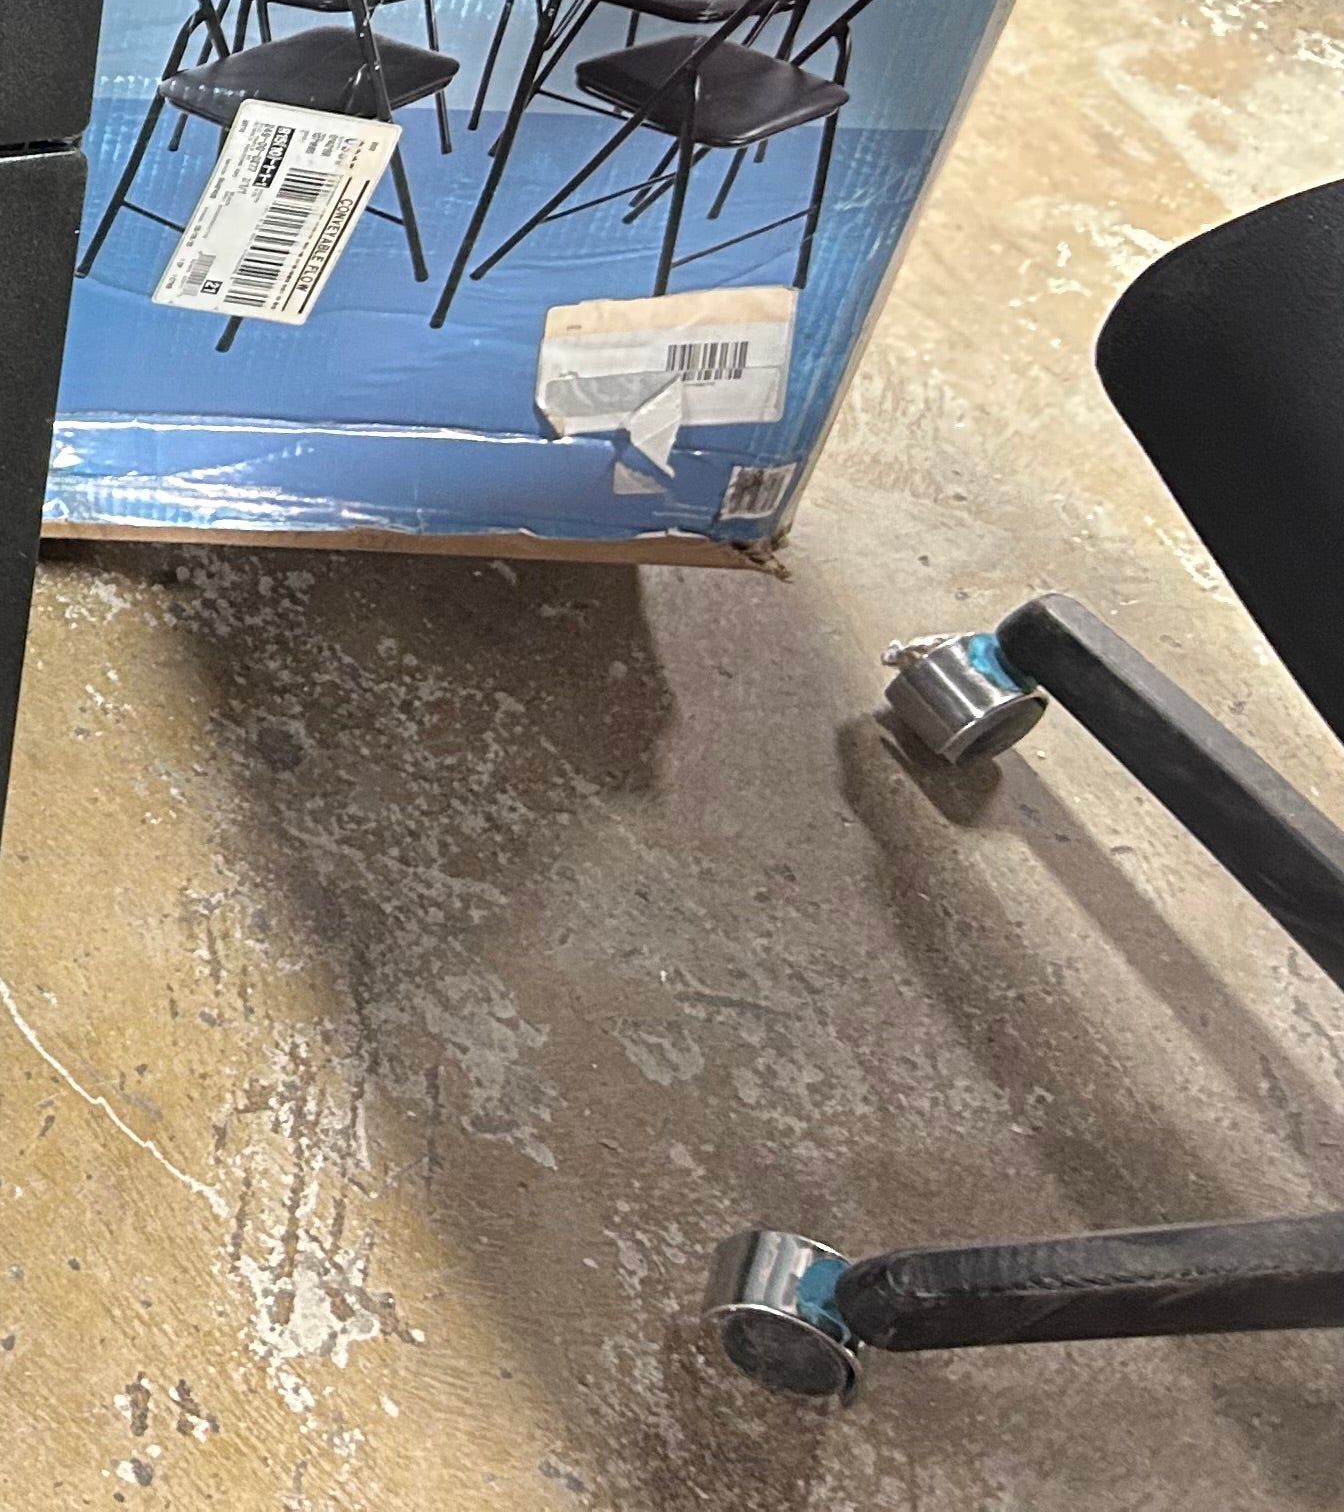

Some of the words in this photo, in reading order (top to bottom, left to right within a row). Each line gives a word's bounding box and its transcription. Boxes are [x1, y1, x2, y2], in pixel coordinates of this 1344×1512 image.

[311, 198, 353, 262] CONVEYABLE
[202, 281, 219, 293] 21
[295, 264, 320, 293] FLOW
